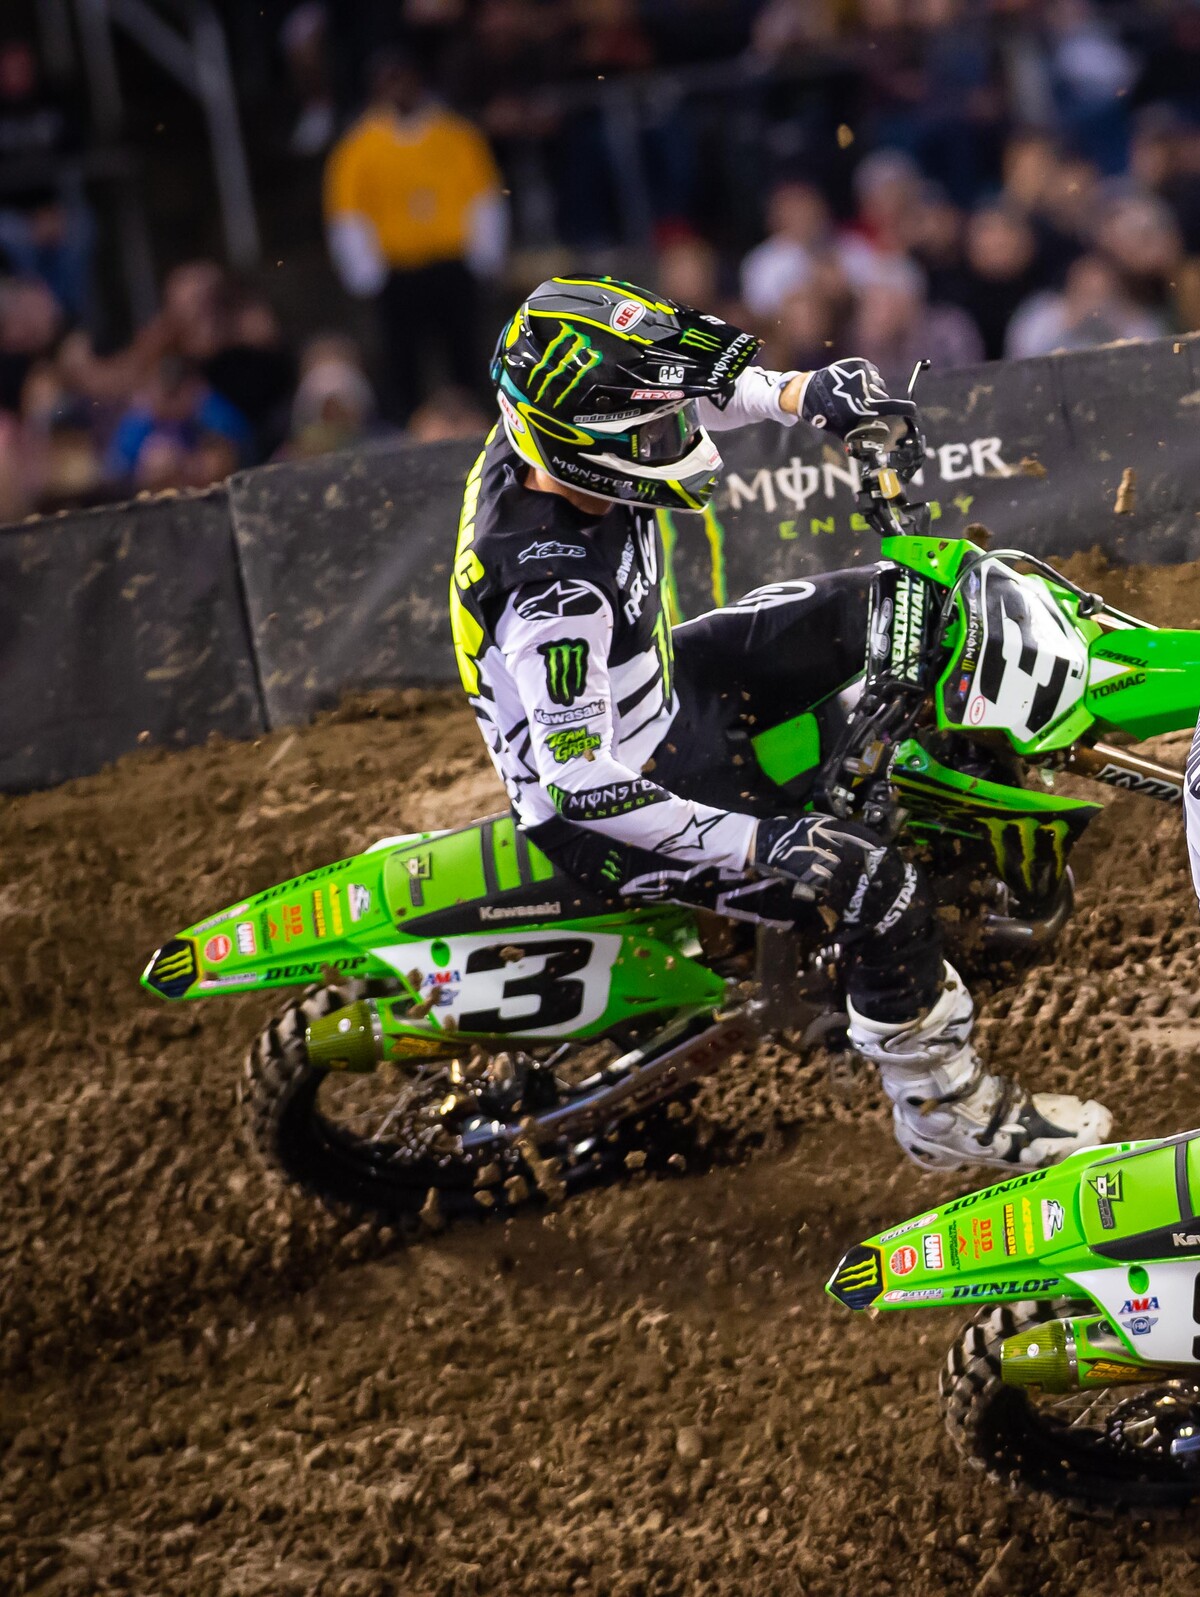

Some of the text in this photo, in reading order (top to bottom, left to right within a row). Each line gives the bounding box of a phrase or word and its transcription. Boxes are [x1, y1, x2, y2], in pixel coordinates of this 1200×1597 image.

[616, 304, 641, 326] BELL
[707, 333, 755, 385] MONSTER
[725, 437, 1014, 513] MONER
[1090, 673, 1146, 700] TOMAC
[534, 700, 607, 725] Kawasaki
[480, 901, 561, 921] Kawasaki
[264, 956, 368, 981] DUNOP
[457, 938, 594, 1033] 3
[944, 1170, 1048, 1215] DUNLOP
[951, 1278, 1060, 1299] DUNLOP
[1118, 1297, 1160, 1315] AMA
